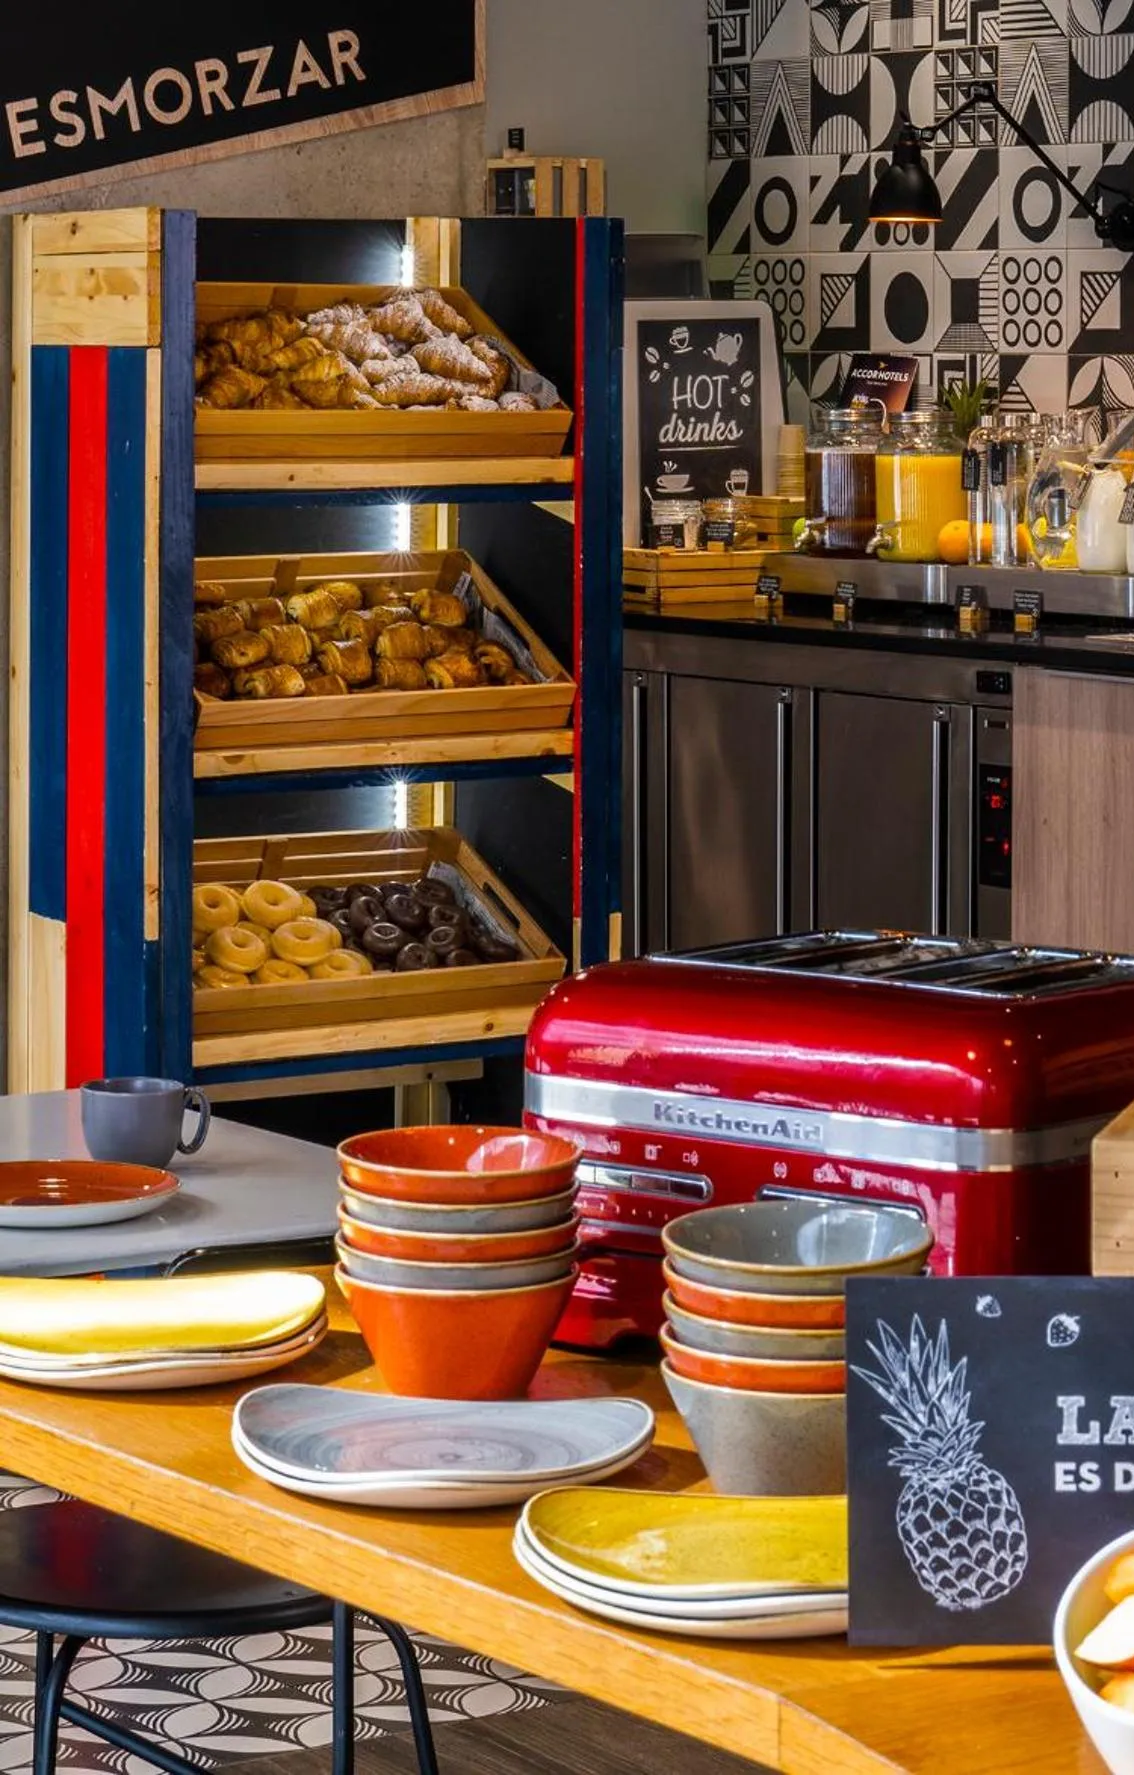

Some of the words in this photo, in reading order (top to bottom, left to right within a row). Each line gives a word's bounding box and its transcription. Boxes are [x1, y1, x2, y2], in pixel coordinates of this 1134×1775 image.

[5, 29, 366, 158] ESMORZAR
[672, 374, 729, 410] HOT
[658, 411, 744, 443] drinks
[654, 1102, 823, 1141] KitchenAid
[1054, 1461, 1101, 1493] ES
